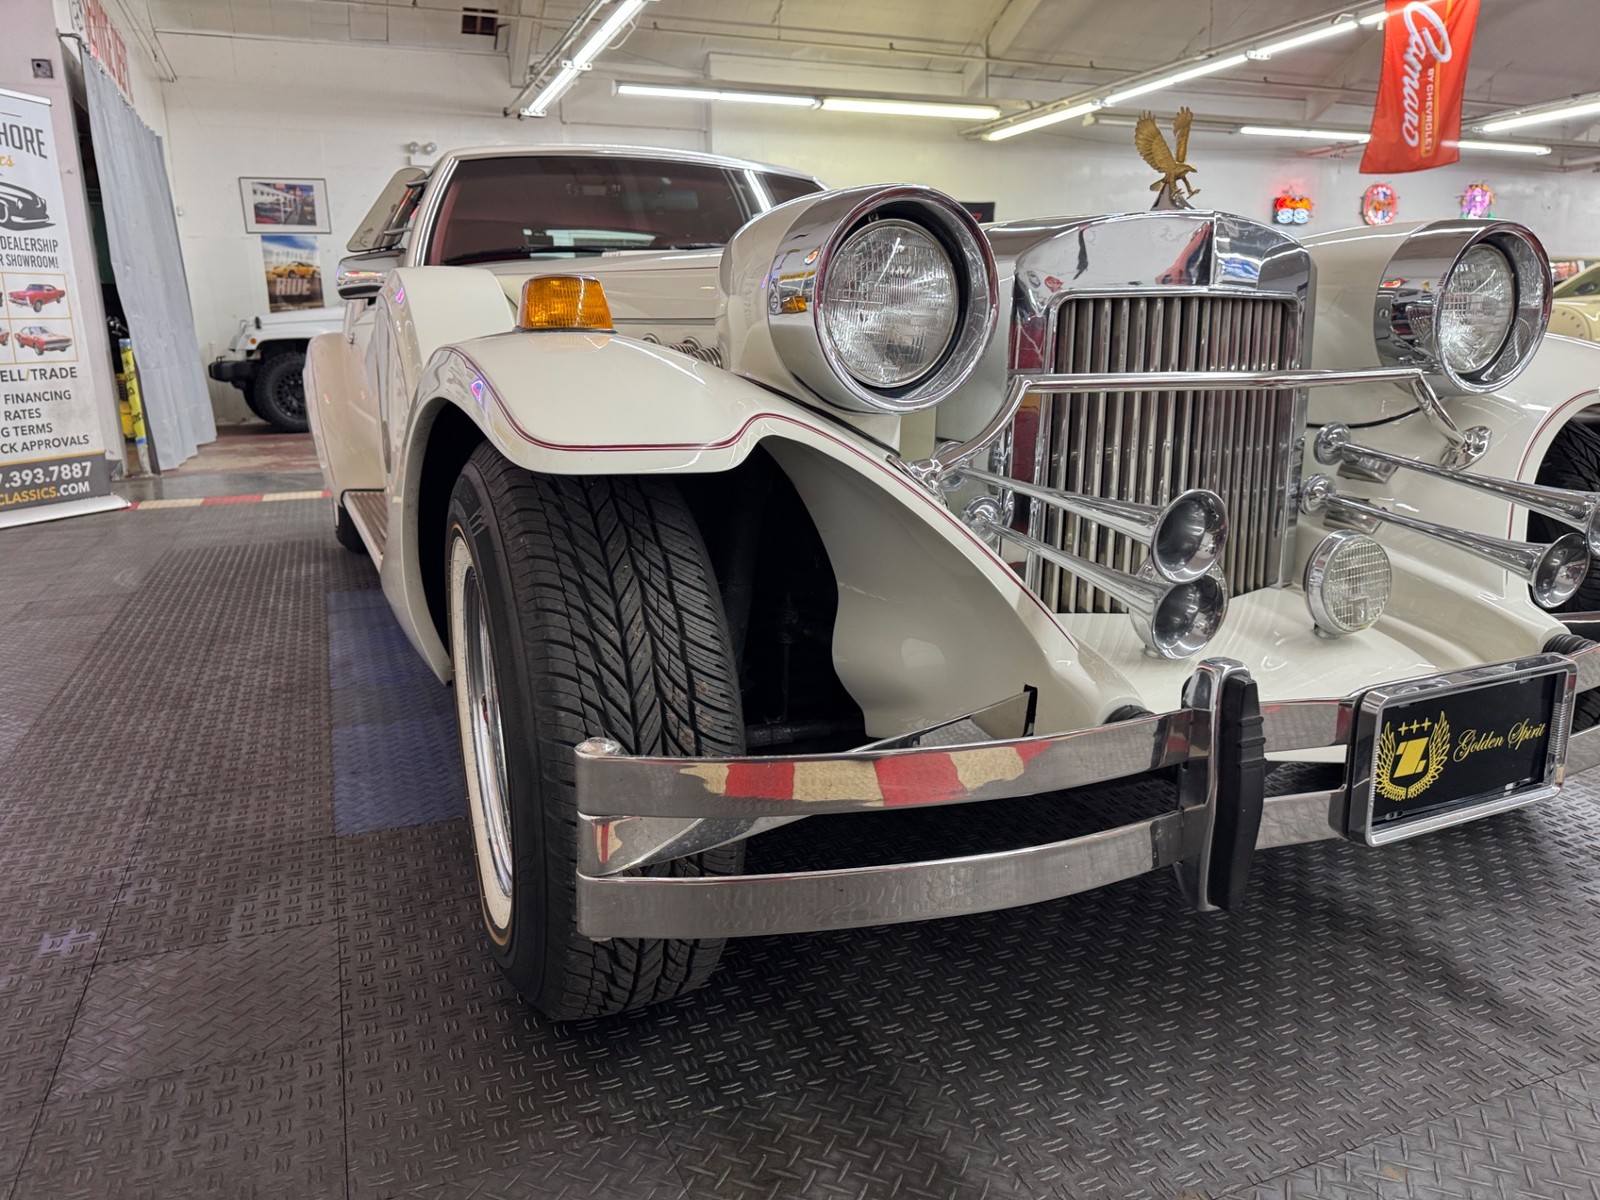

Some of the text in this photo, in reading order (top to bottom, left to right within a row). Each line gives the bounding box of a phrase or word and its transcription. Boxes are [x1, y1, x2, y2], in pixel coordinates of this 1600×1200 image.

[1402, 1, 1452, 147] Camaro
[1424, 67, 1434, 153] BY CHEVROLET
[0, 235, 59, 253] DEALERSHIP
[5, 253, 60, 269] SHOWROOM!
[4, 390, 71, 404] FINANCING
[4, 408, 41, 421] RATES
[12, 423, 53, 436] TERMS
[21, 435, 89, 451] APPROVALS
[1453, 718, 1546, 762] Golden Spirit
